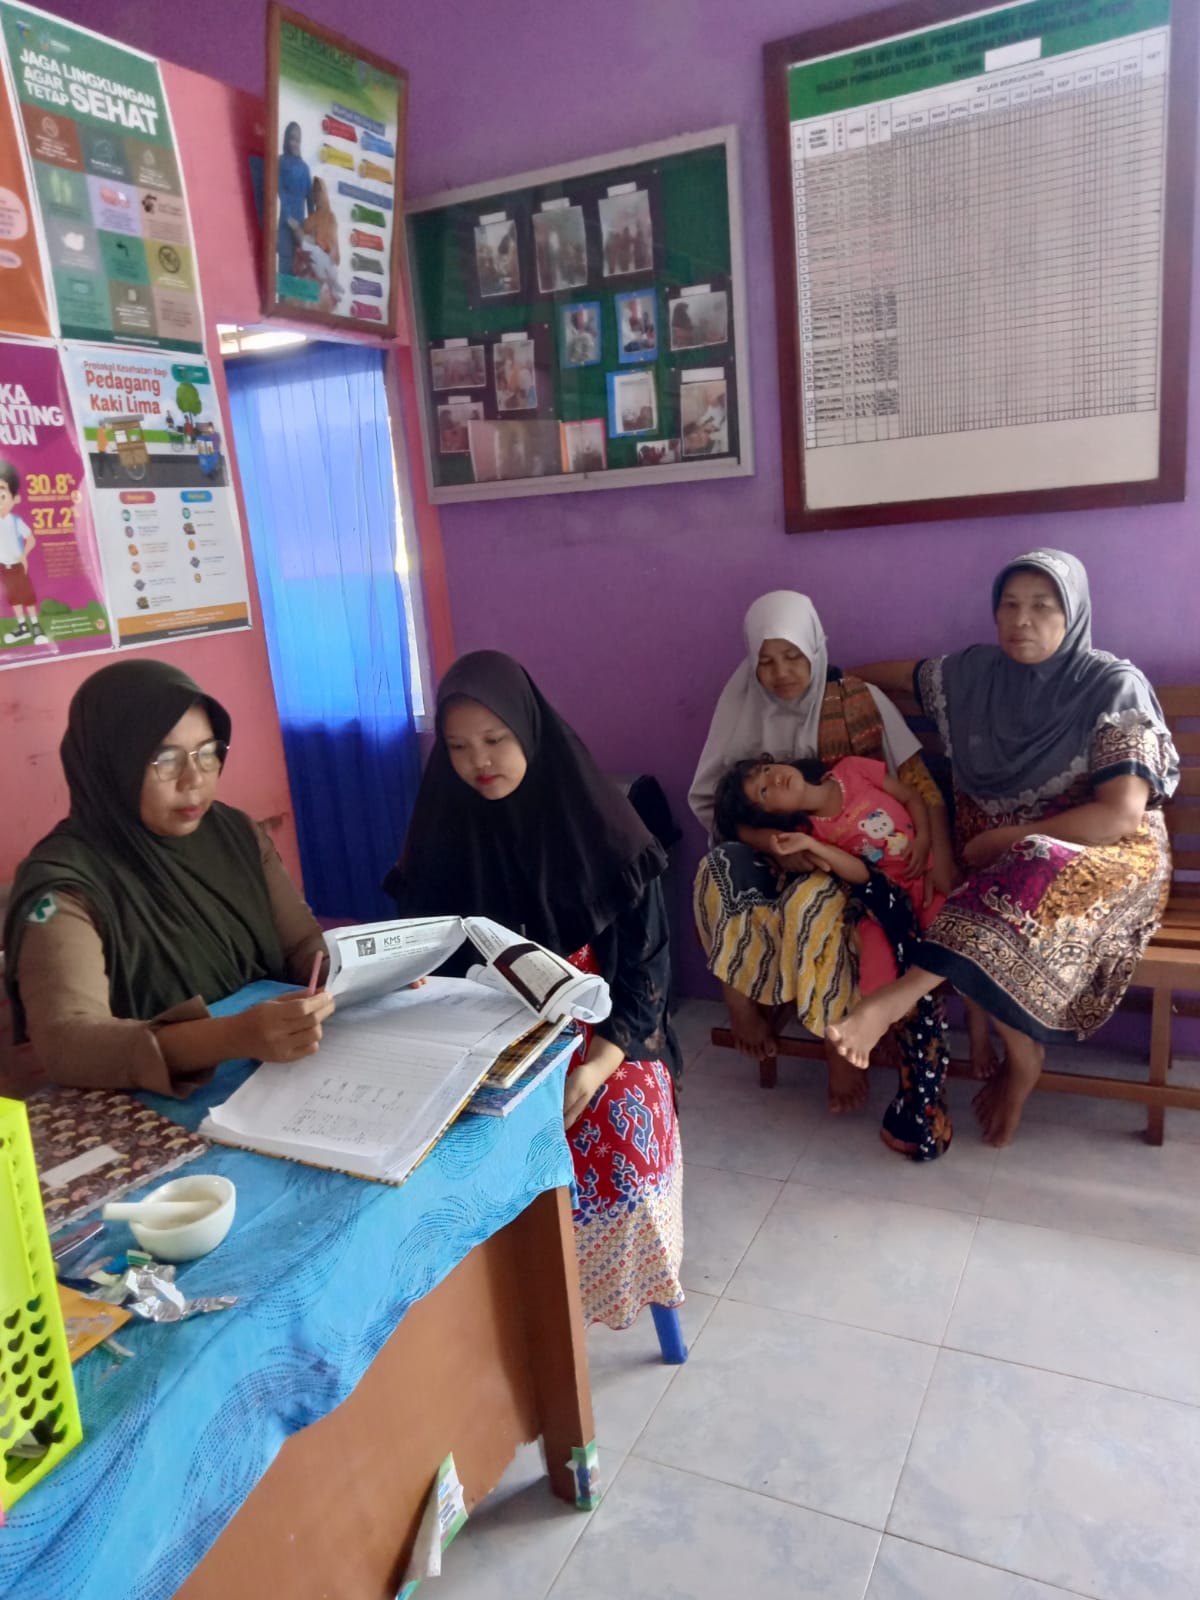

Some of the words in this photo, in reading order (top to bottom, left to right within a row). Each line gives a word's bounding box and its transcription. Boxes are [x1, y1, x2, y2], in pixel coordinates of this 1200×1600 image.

[20, 49, 61, 75] JAGA
[62, 63, 156, 109] LINGKUNGAN
[24, 66, 64, 91] AGAR
[24, 80, 70, 106] TETAP
[69, 83, 158, 136] SEHAT
[85, 370, 161, 397] Pedagang
[89, 394, 123, 412] Kaki
[126, 397, 161, 415] Lima
[383, 935, 401, 946] KMS
